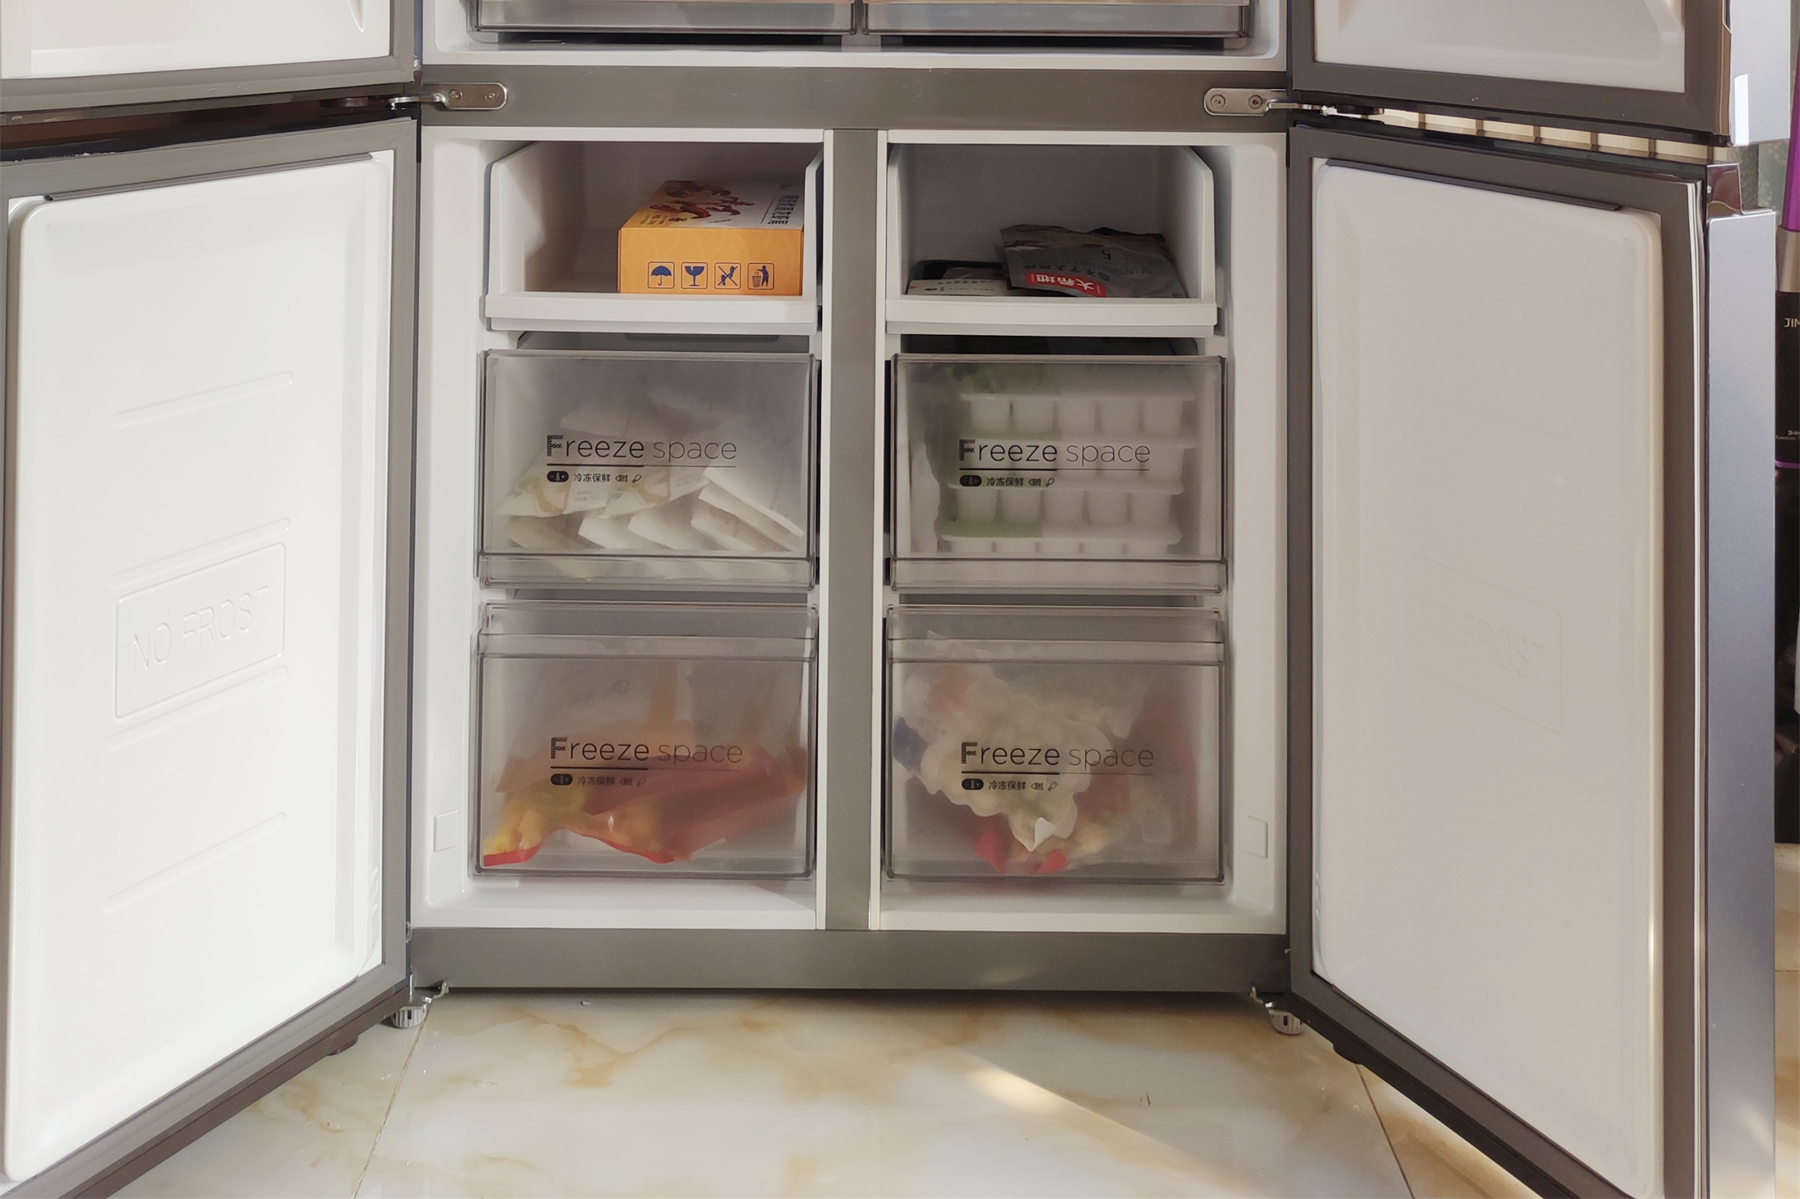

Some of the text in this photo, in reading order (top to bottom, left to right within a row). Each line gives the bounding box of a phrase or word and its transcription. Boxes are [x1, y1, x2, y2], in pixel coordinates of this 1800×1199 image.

[547, 434, 737, 463] Freeze space
[959, 439, 1151, 466] Freeze space
[573, 473, 611, 483] 冷冻保鲜
[986, 477, 1024, 487] 冷冻保鲜
[133, 585, 269, 671] NO FROST
[551, 737, 743, 765] Freeze space
[961, 742, 1154, 770] Freeze space
[577, 776, 615, 786] 冷冻保鲜
[988, 781, 1026, 791] 冷冻保鲜
